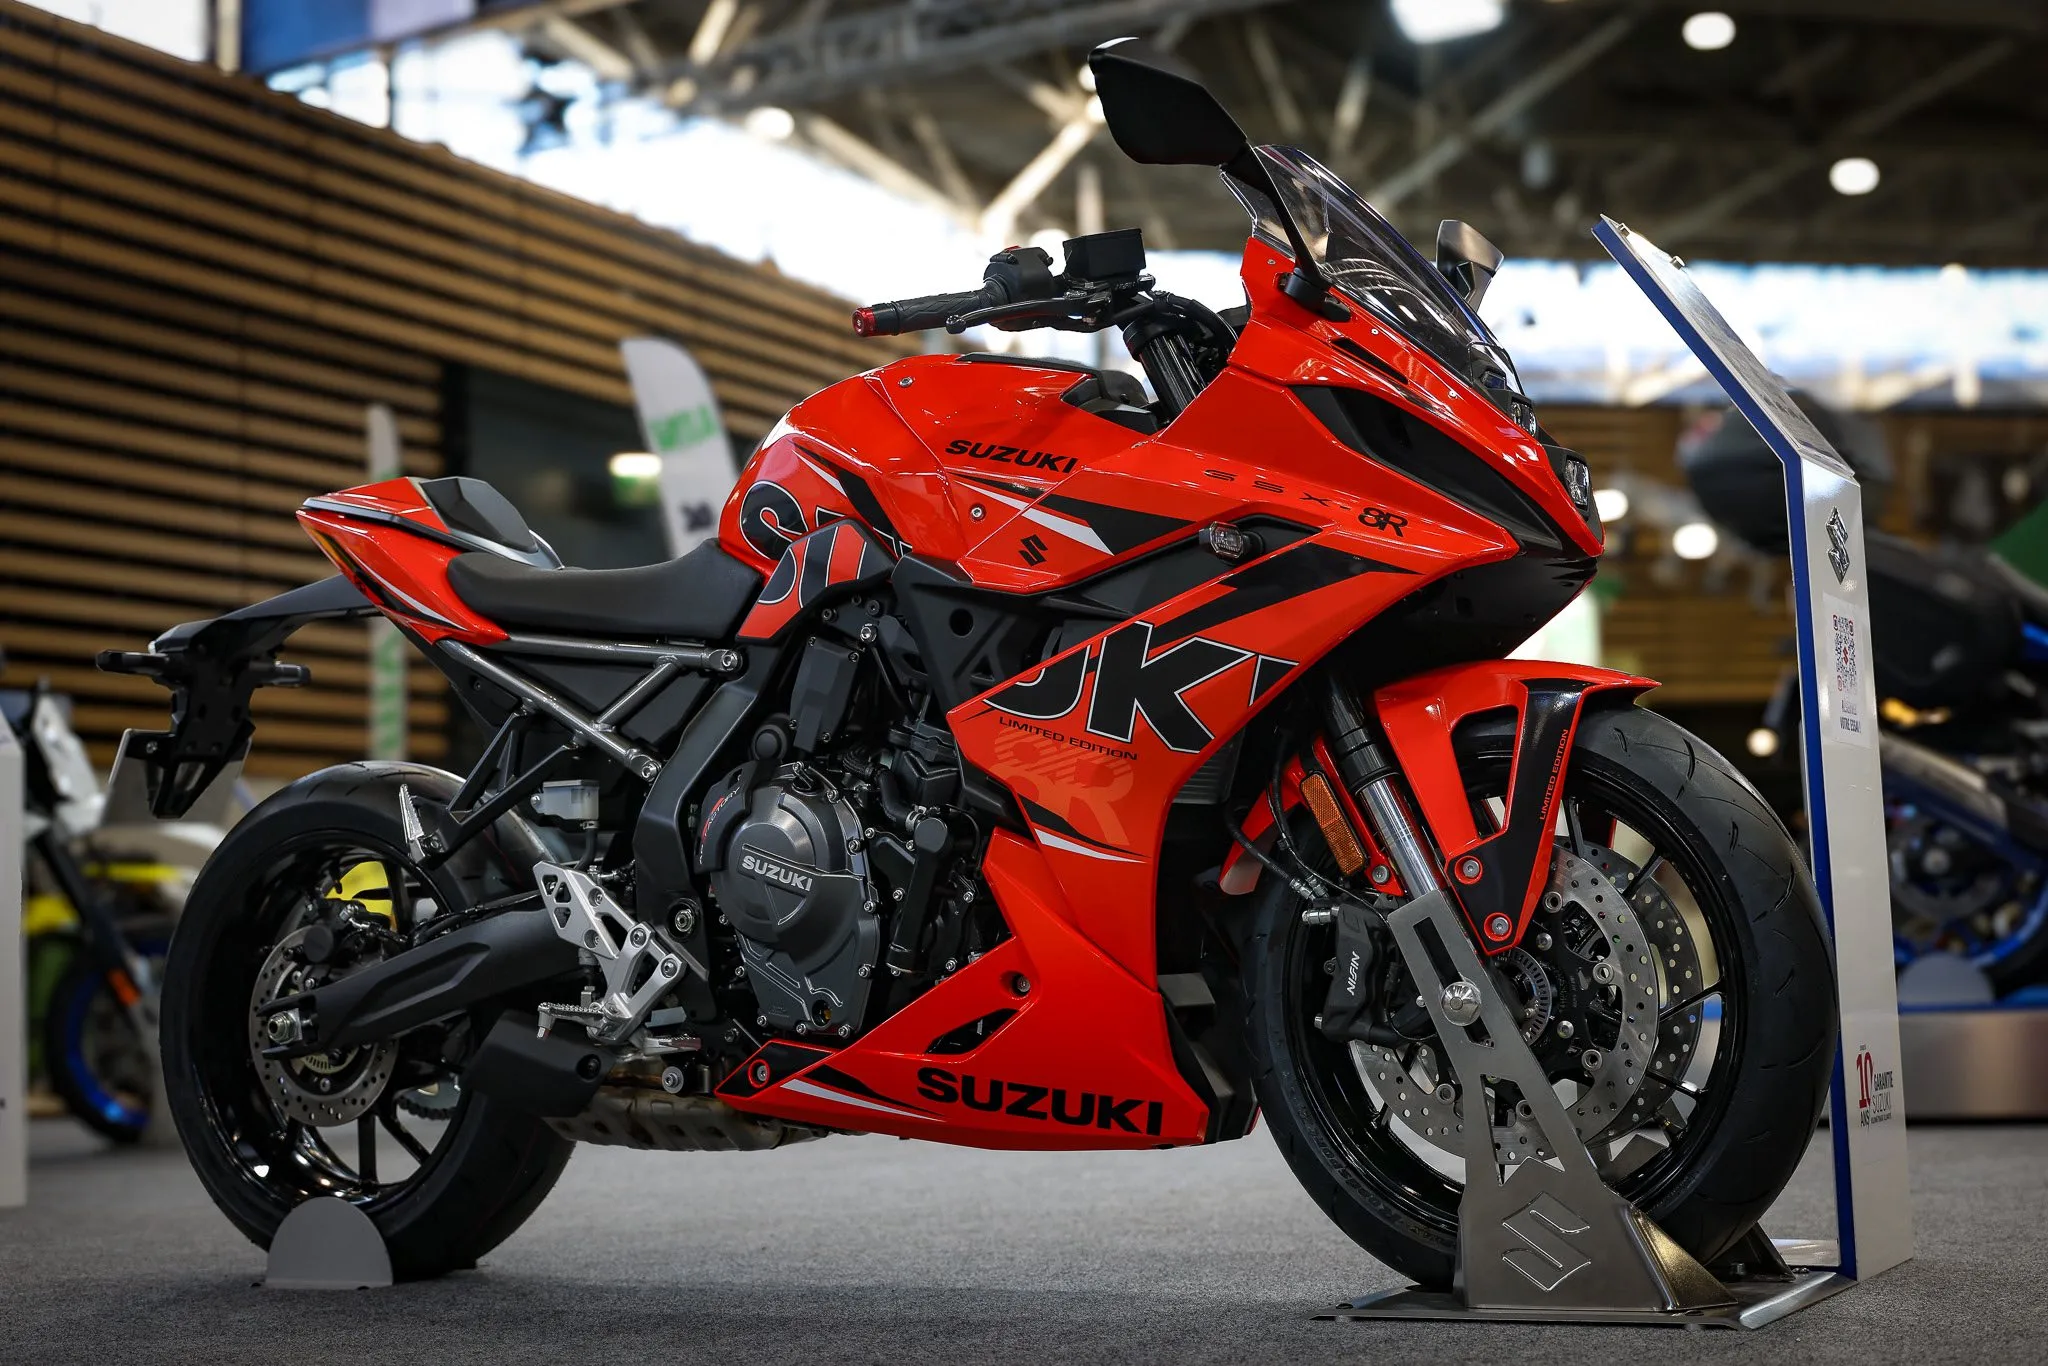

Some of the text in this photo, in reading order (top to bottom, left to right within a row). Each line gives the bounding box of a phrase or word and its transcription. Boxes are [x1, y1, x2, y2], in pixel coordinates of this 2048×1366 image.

[945, 439, 1078, 474] SUZUKI
[999, 716, 1138, 760] LIMITED EDITION
[1539, 729, 1569, 821] LIMITED EDITION
[742, 855, 813, 892] SUZUKI
[1856, 1052, 1874, 1109] 10
[1873, 1071, 1894, 1091] GARANTIE
[917, 1067, 1163, 1136] SUZUKI
[1860, 1110, 1871, 1127] ANS
[1872, 1092, 1891, 1113] SUZUKI
